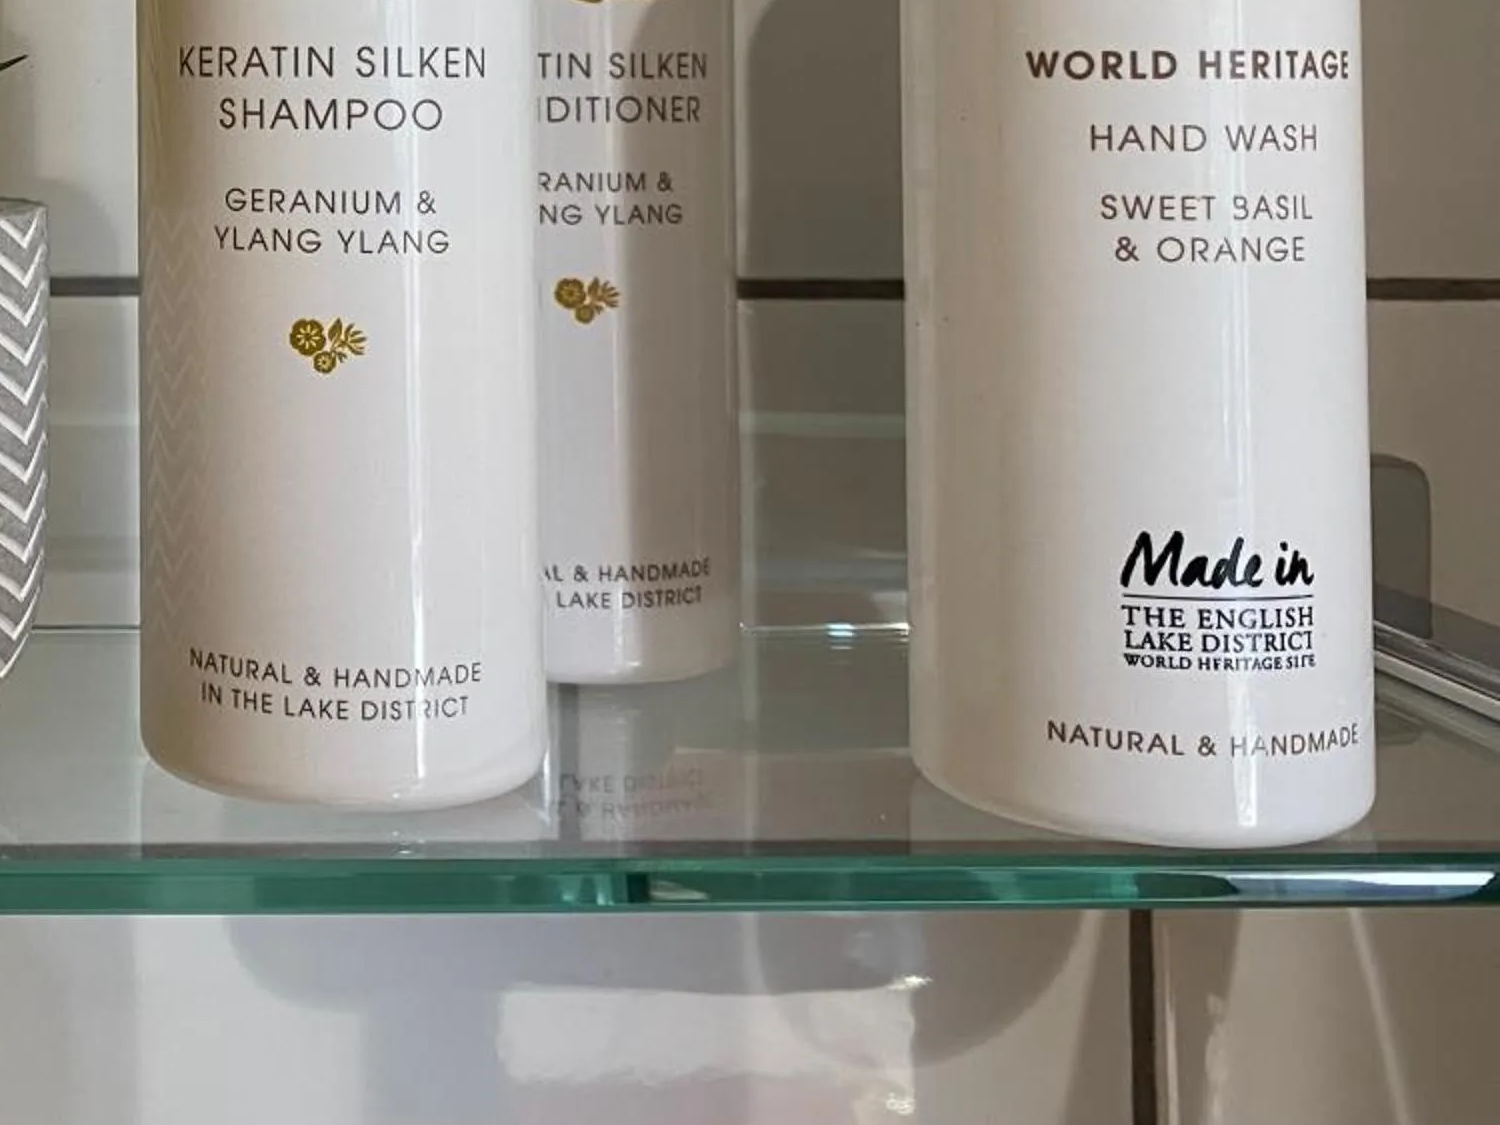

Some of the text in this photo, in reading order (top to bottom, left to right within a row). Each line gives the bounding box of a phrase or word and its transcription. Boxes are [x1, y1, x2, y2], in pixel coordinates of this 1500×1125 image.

[179, 46, 486, 78] KERATIN SILKEN
[609, 52, 707, 80] SILKEN
[1025, 50, 1349, 80] WORLD HERITAGE
[219, 98, 442, 131] SHAMPOO
[537, 95, 700, 124] DITIONER
[1091, 124, 1317, 152] HAND WASH
[538, 171, 673, 192] RANIUM &
[225, 188, 436, 214] GERANIUM &
[594, 204, 683, 225] YLANG
[1100, 195, 1313, 221] SWEET BASIL
[214, 227, 450, 255] YLANG YLANG
[1115, 236, 1305, 262] & ORANGE
[573, 564, 588, 582] &
[598, 556, 710, 582] HANDMADE
[1120, 531, 1314, 589] Made in
[556, 585, 702, 609] LAKE DISTRICT
[1121, 605, 1313, 629] THE ENGLISH
[1124, 630, 1313, 653] LAKE DISTRICT
[190, 647, 481, 688] NATURAL & HANDMADE
[1124, 653, 1192, 669] WORLD
[1199, 656, 1282, 671] HERITAGE
[202, 681, 469, 721] IN THE LAKE DISTRICT
[1047, 720, 1358, 757] NATURAL & HANDMADE
